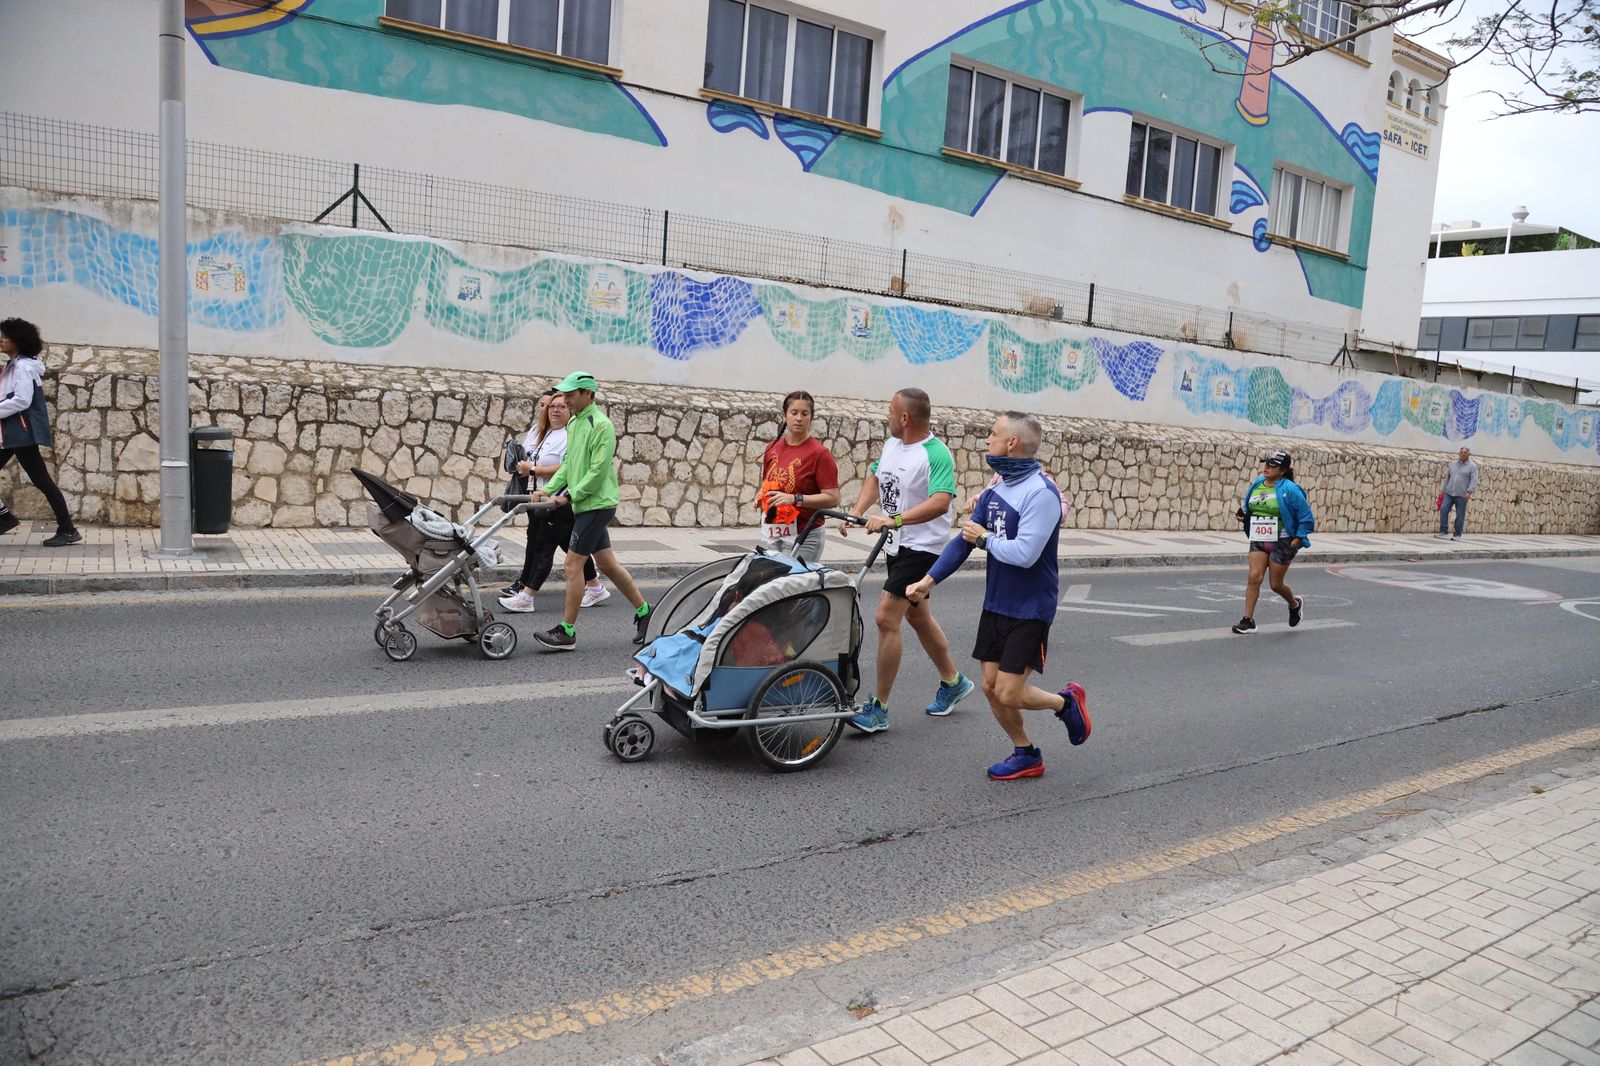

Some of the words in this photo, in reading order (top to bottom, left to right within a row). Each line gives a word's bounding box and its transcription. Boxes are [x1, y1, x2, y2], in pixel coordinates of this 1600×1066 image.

[1383, 129, 1402, 147] SAFA
[1411, 140, 1428, 156] ICET
[768, 526, 791, 538] 134
[1255, 526, 1272, 535] 404
